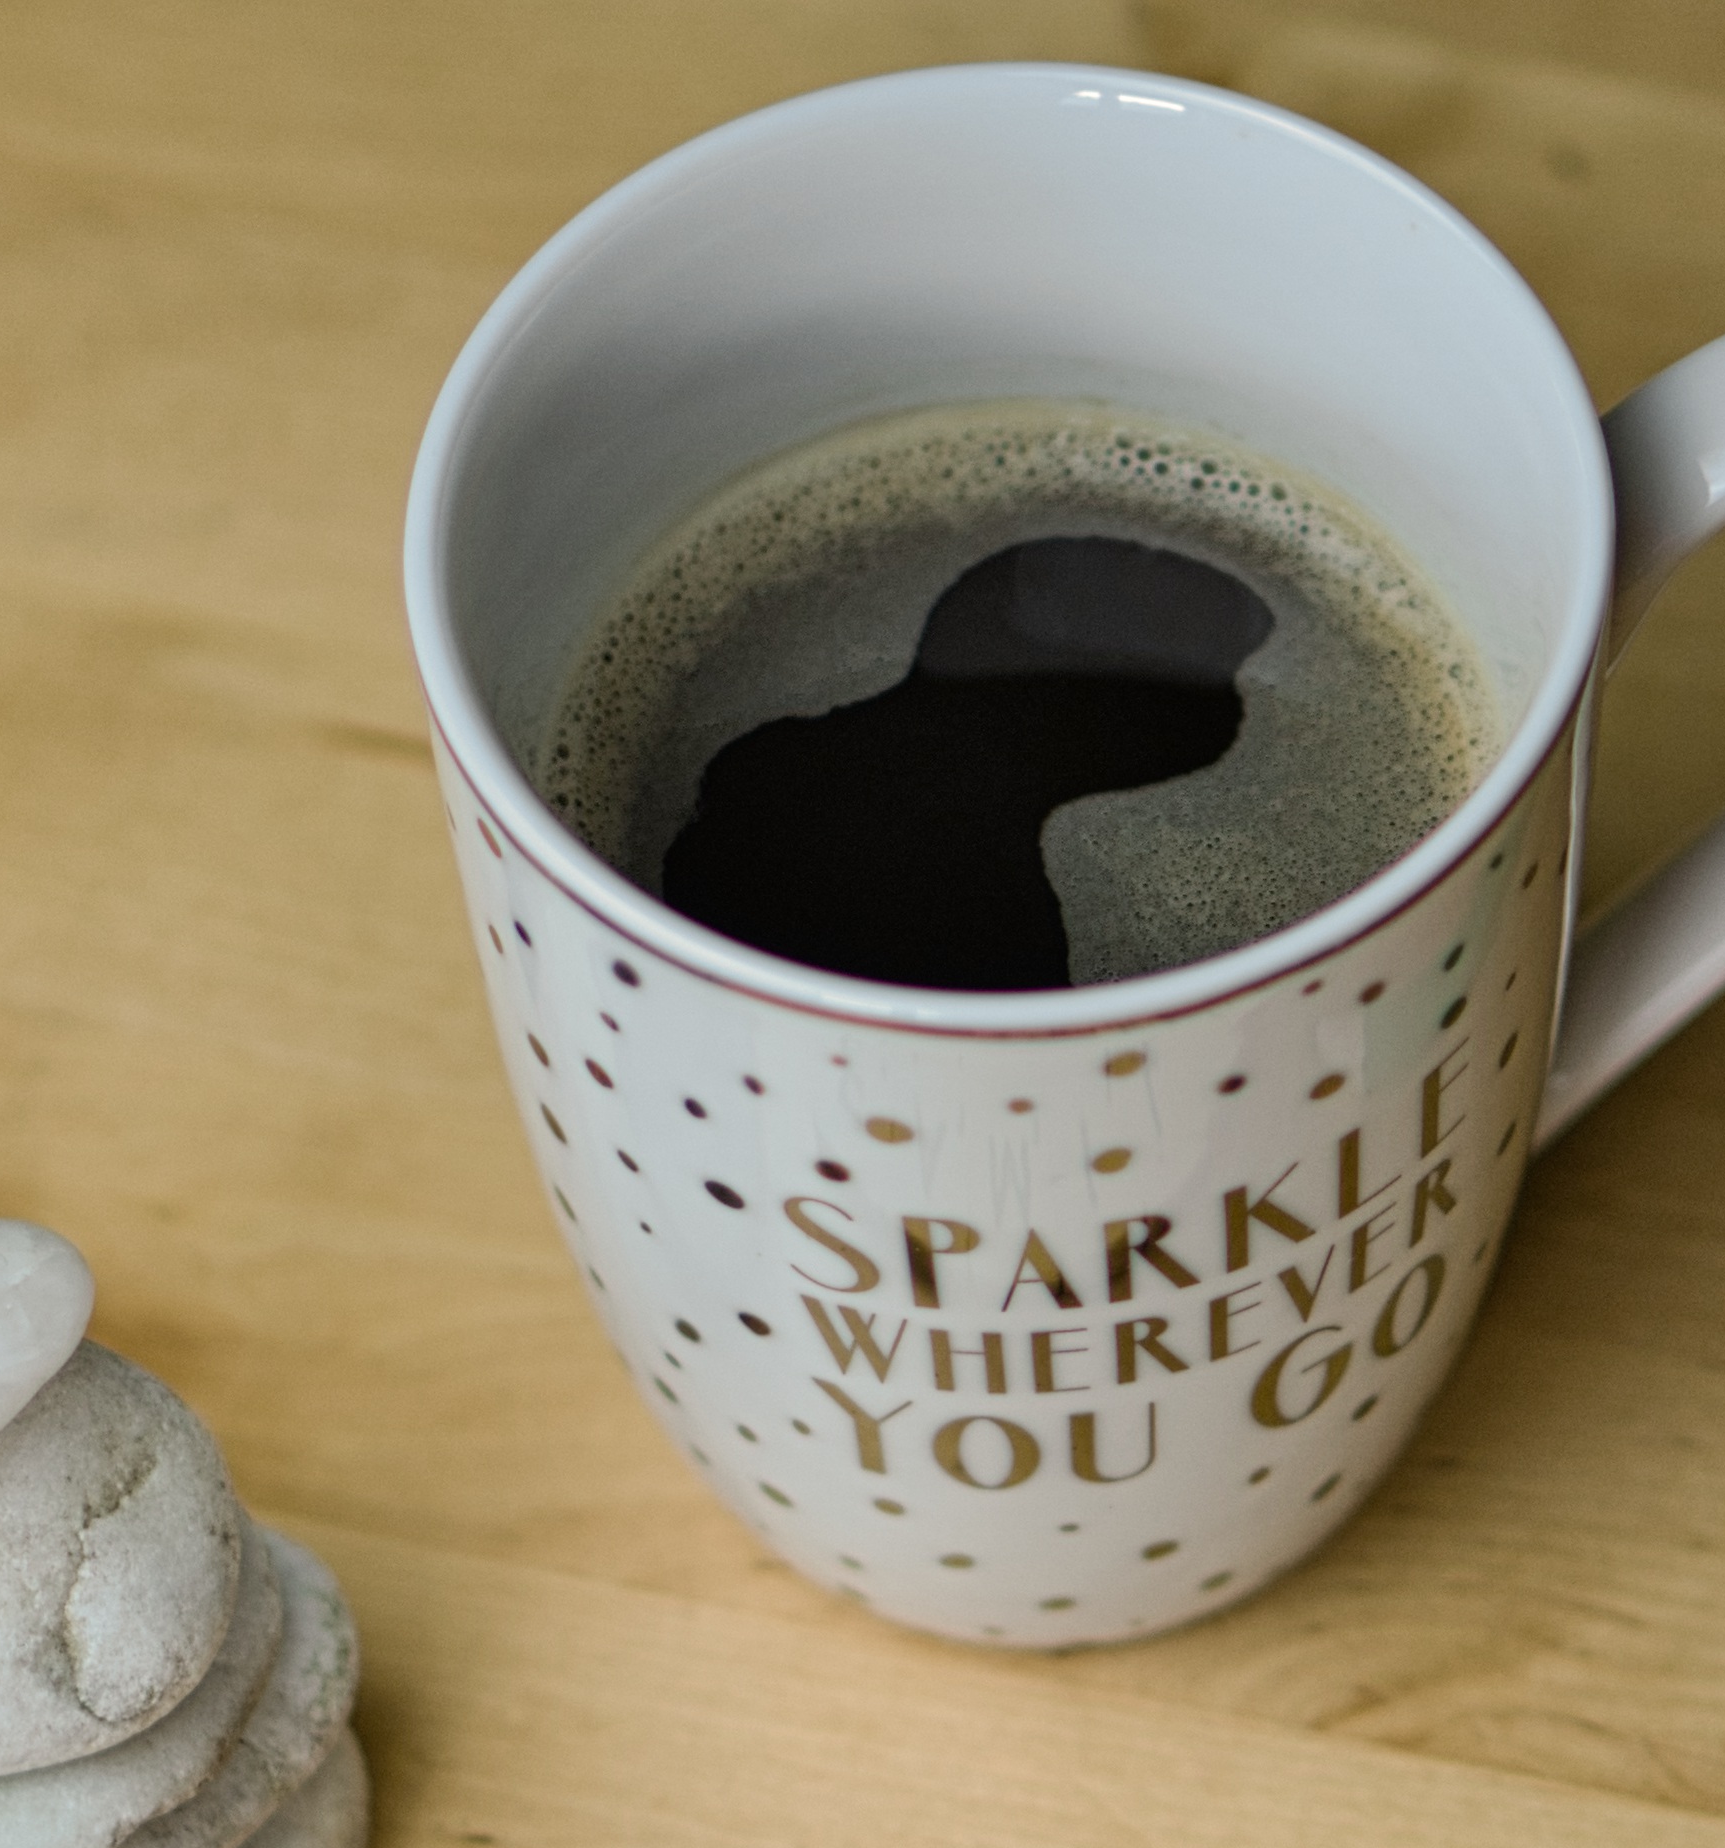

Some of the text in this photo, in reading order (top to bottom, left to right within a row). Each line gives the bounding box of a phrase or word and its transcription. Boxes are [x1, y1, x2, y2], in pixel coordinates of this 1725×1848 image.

[783, 1037, 1471, 1311] SPARKLE
[800, 1158, 1457, 1394] WHEREVER
[811, 1253, 1446, 1490] YOU GO
